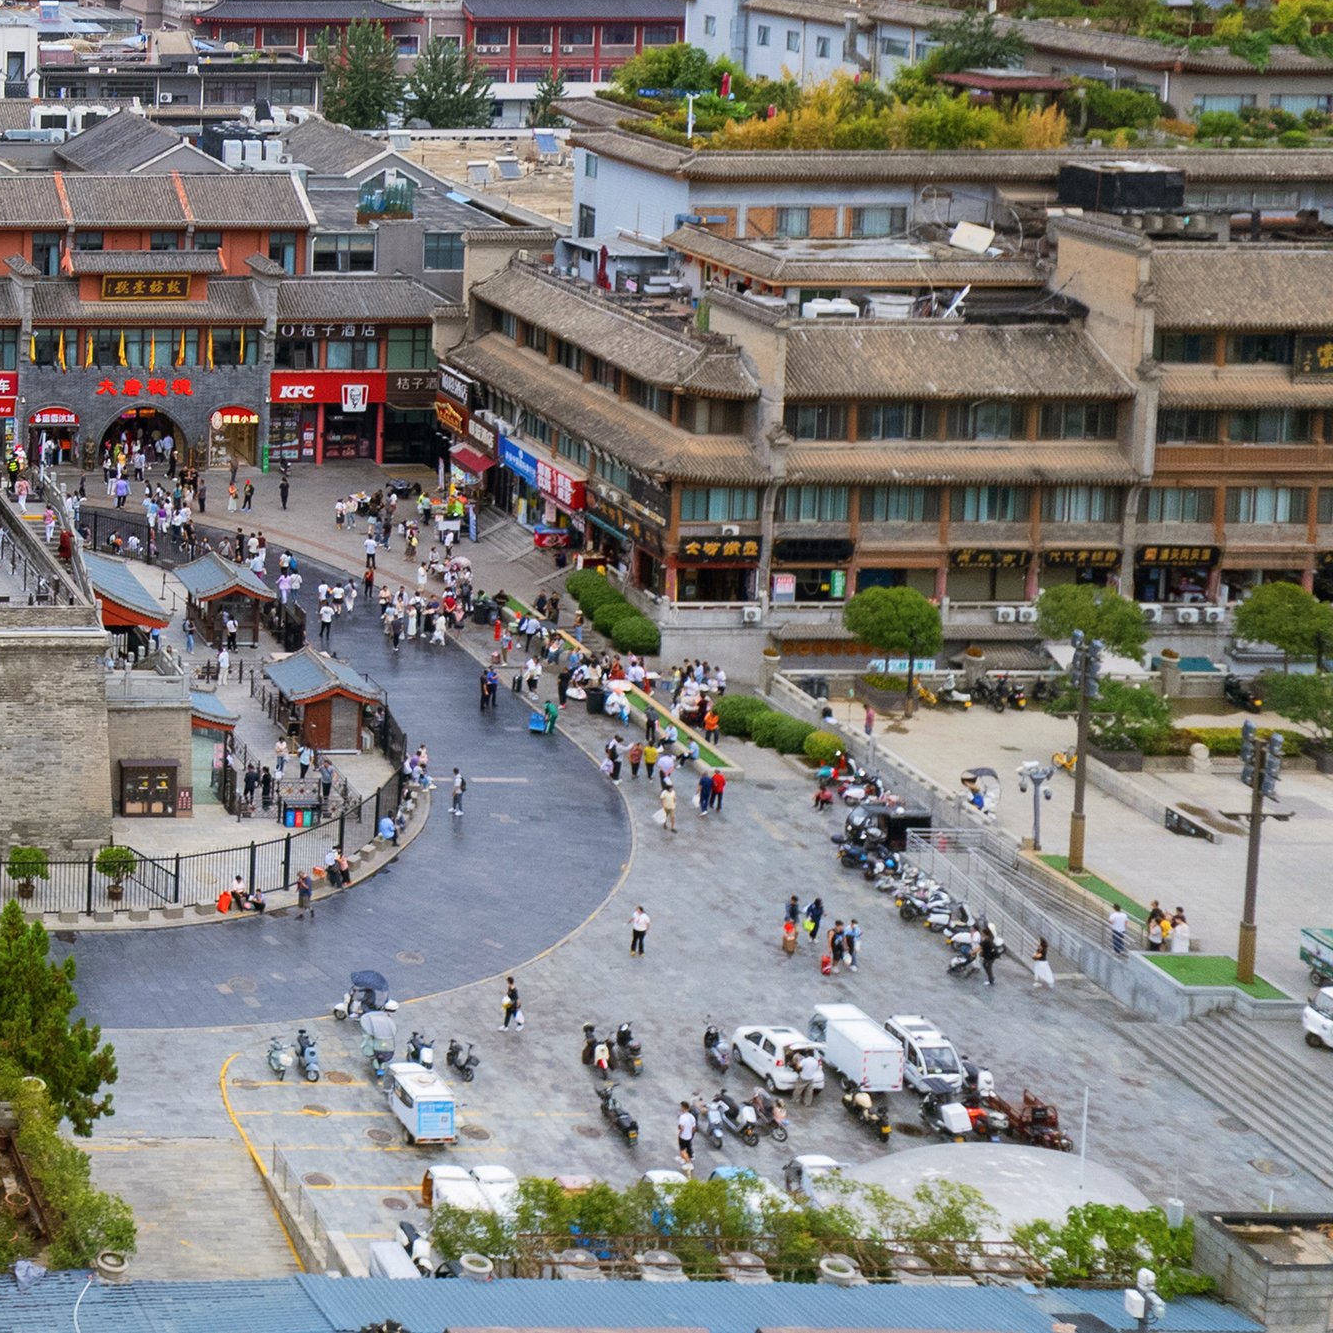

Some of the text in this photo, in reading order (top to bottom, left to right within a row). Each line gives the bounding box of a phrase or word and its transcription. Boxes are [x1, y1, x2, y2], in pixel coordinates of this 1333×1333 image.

[300, 324, 375, 337] 桔子酒店
[279, 385, 315, 399] KFC
[41, 413, 76, 423] 蜜雪冰城
